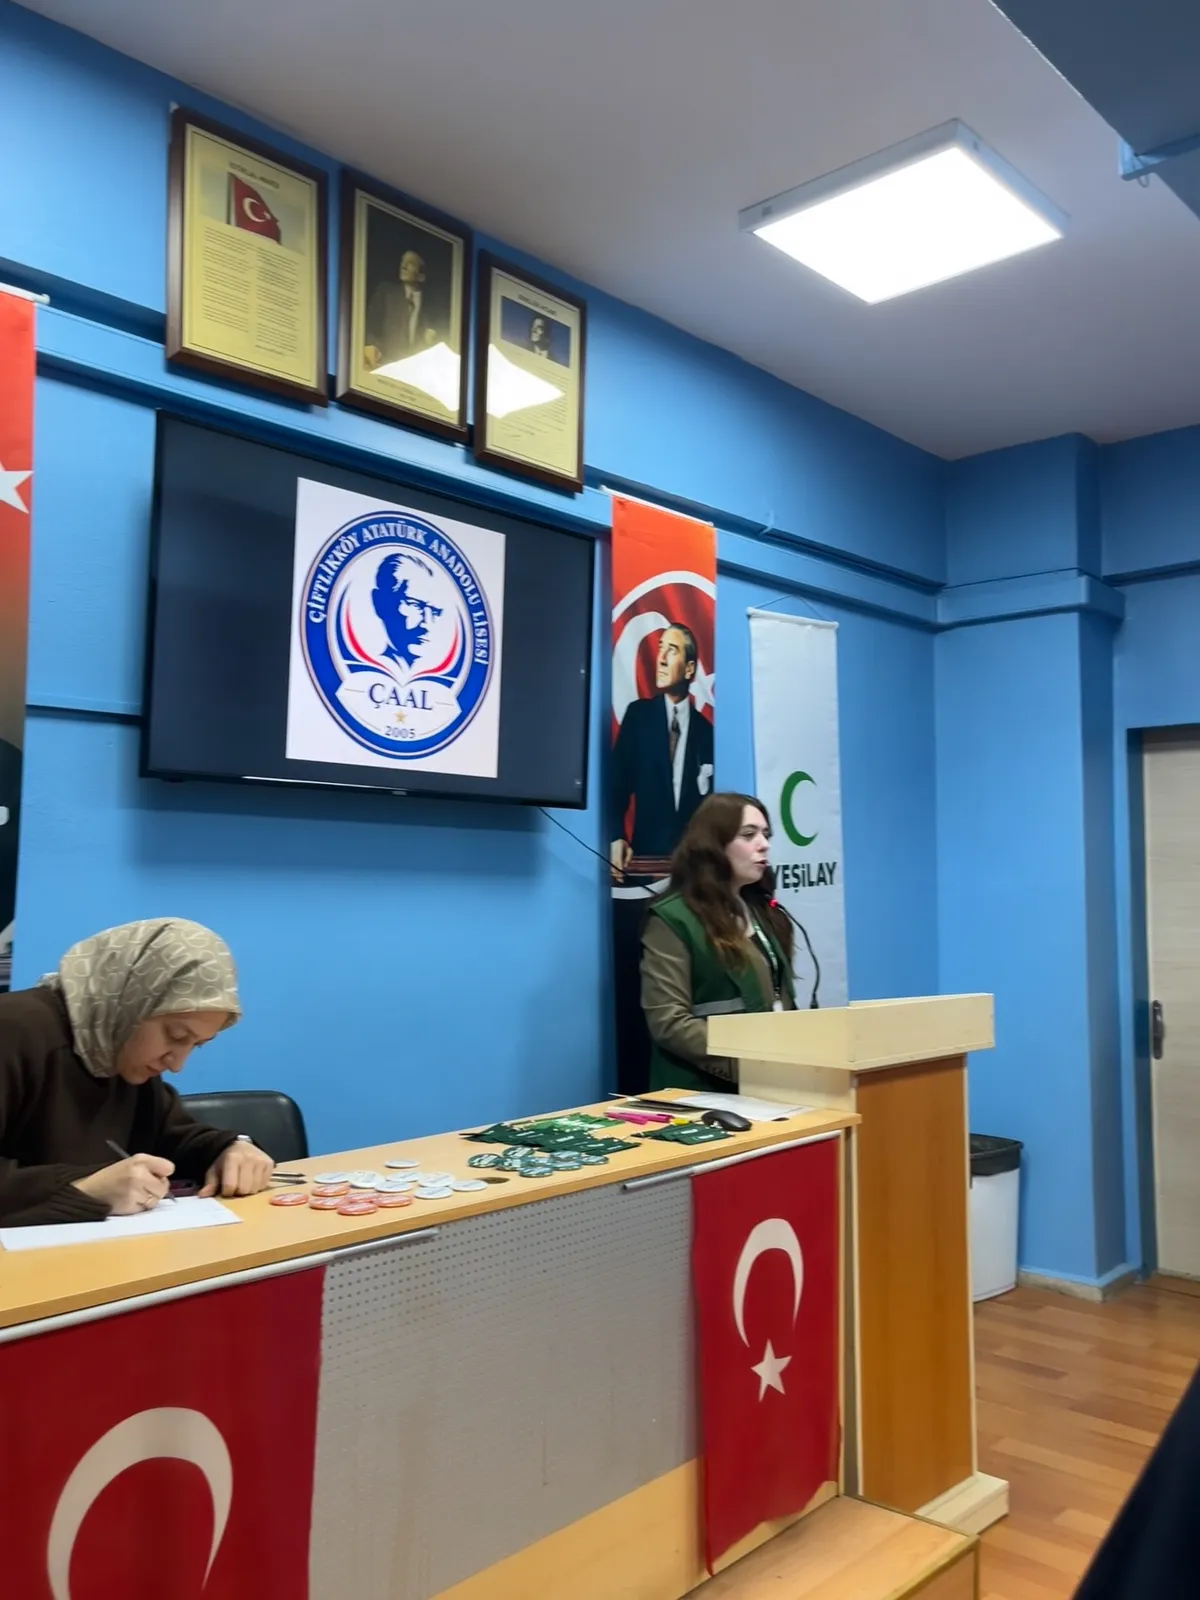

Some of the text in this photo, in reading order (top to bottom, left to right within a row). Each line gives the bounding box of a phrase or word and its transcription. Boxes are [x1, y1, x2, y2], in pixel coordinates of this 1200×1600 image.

[307, 520, 488, 665] ÇİFTLİKKÖY ATATÜRK ANADOLU LİSESİ
[369, 683, 432, 711] ÇAAL
[385, 725, 415, 739] 2005
